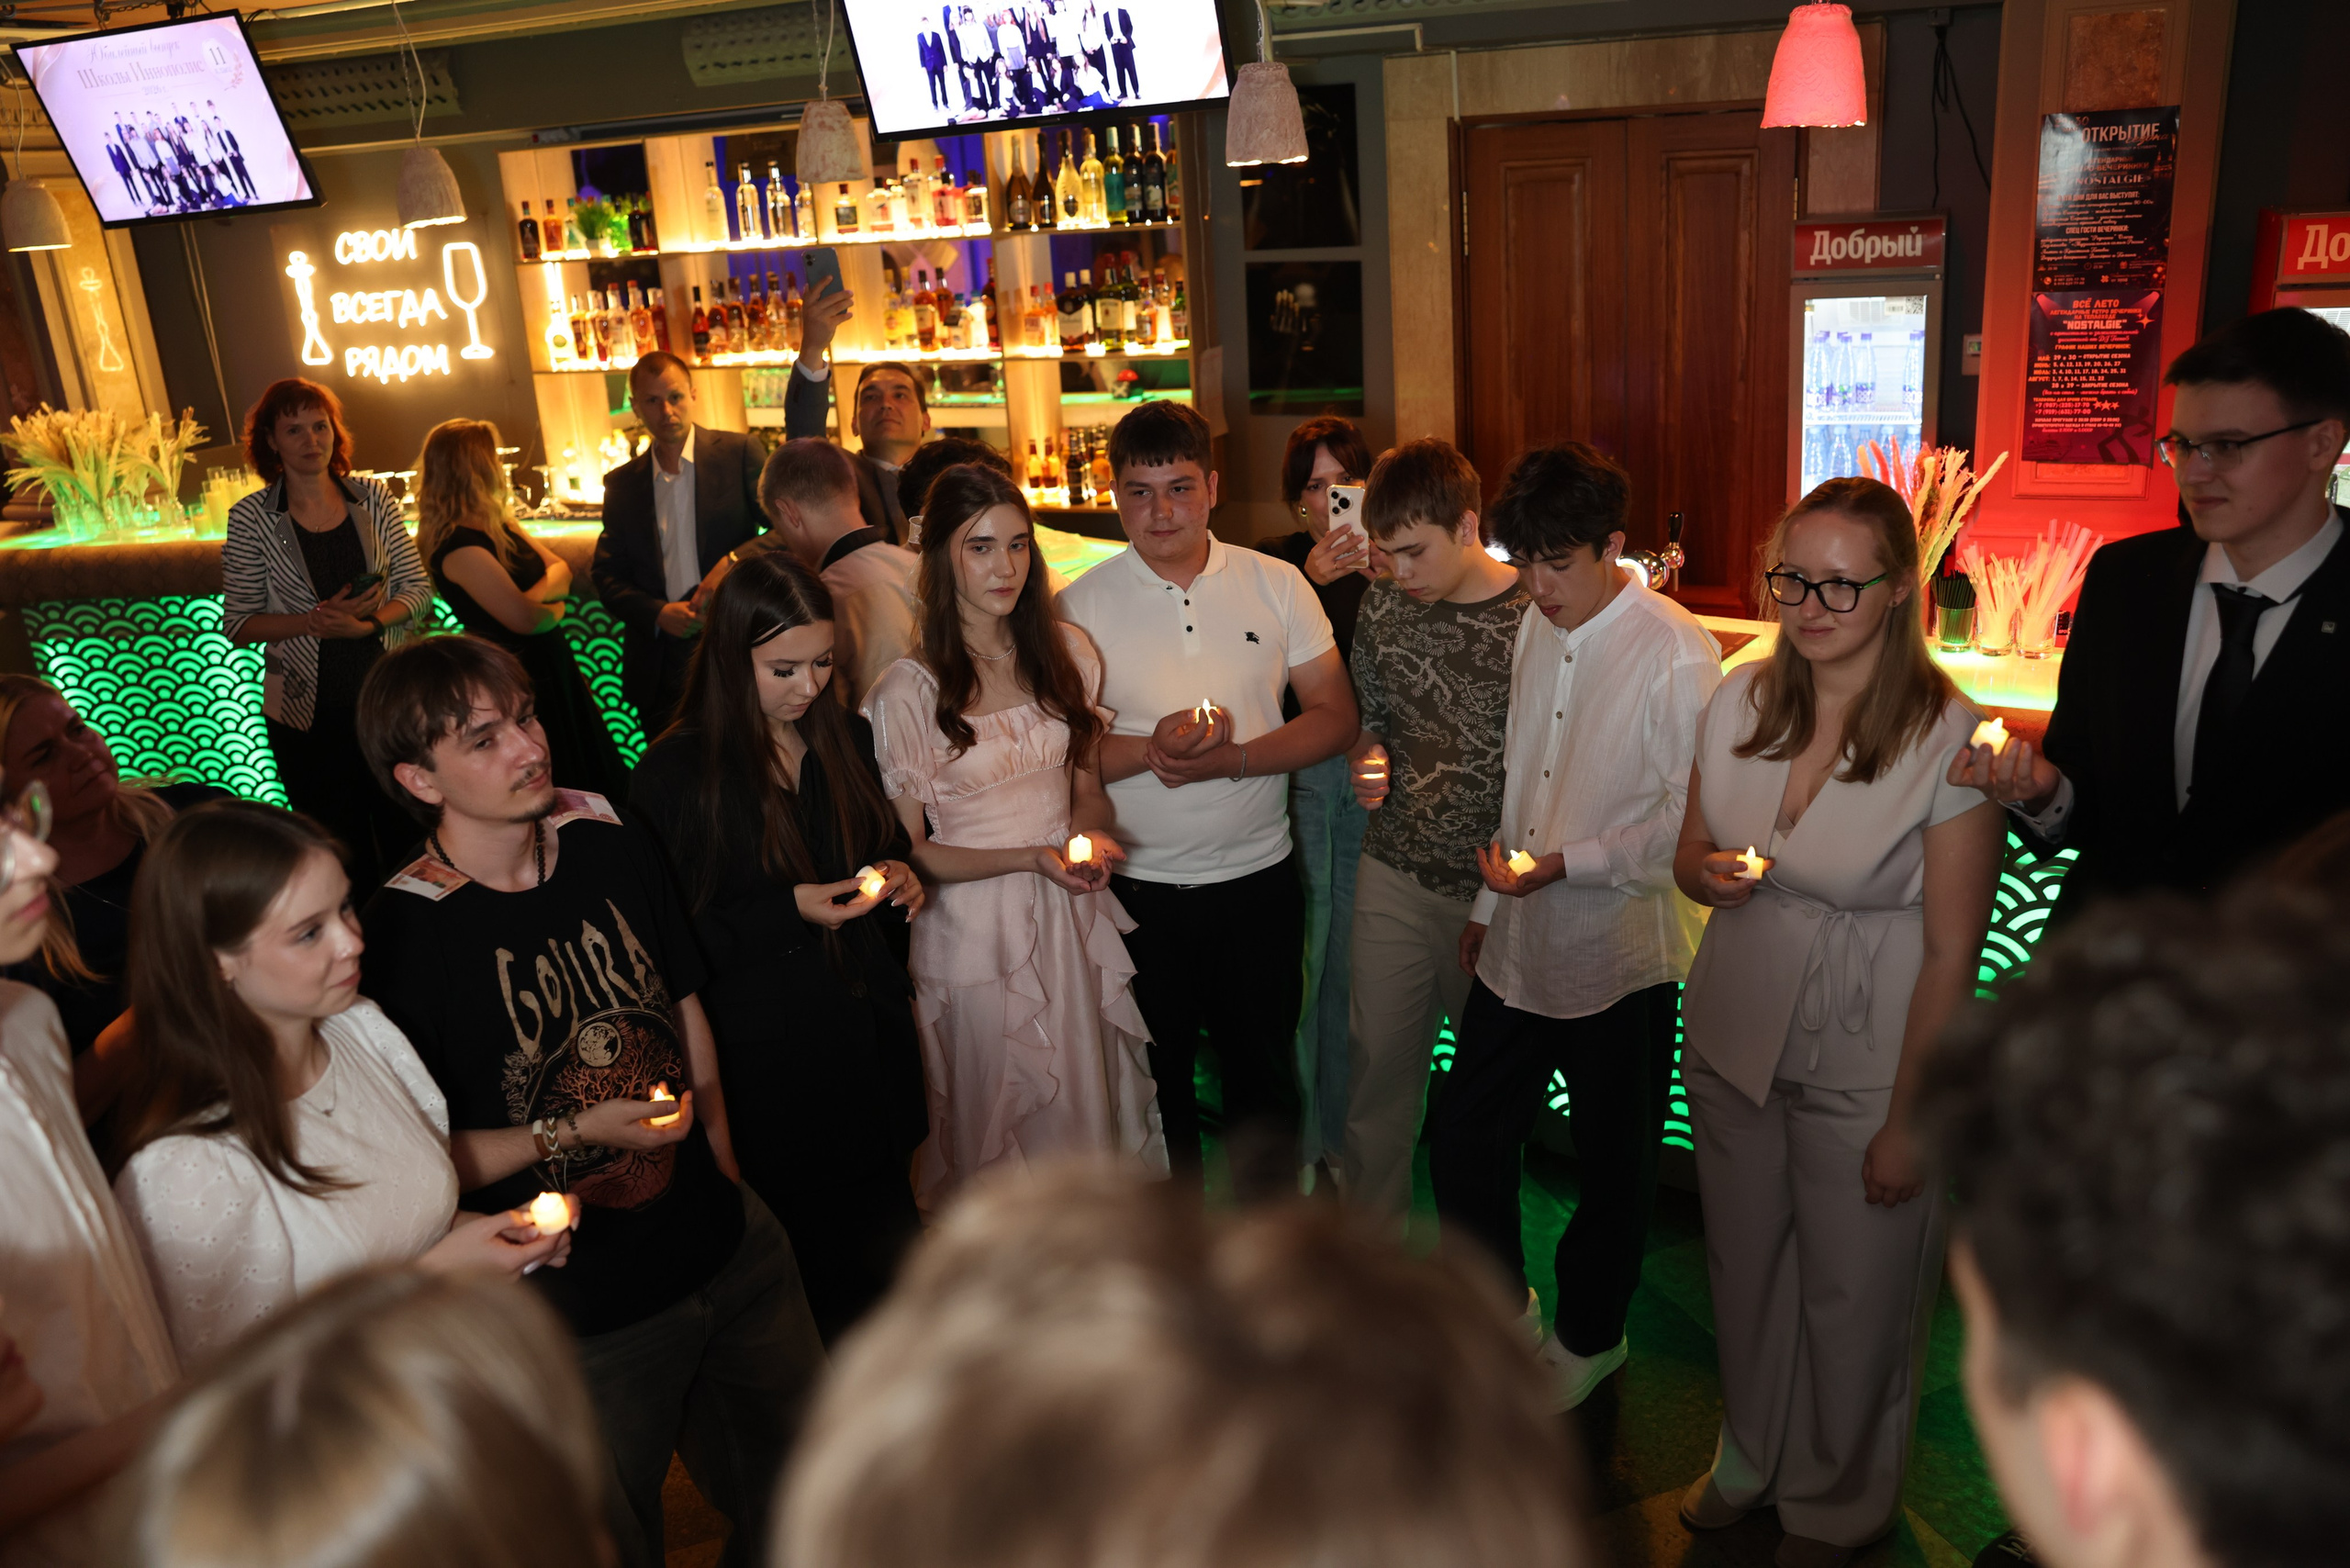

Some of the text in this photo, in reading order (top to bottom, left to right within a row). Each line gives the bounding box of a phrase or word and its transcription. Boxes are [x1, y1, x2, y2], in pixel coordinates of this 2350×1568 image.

[209, 47, 226, 65] 11
[77, 60, 206, 89] Школы Иннополис
[2081, 123, 2160, 144] ОТКРЫТИЕ
[335, 228, 419, 265] СВОИ
[1810, 226, 1922, 265] Добрый
[330, 287, 449, 329] ВСЕГДА
[2073, 297, 2120, 308] ВСЁ ЛЕТО
[2063, 319, 2127, 330] "NOSTALGIE"
[344, 343, 451, 385] РЯДОМ
[495, 899, 655, 1059] GOJIRA
